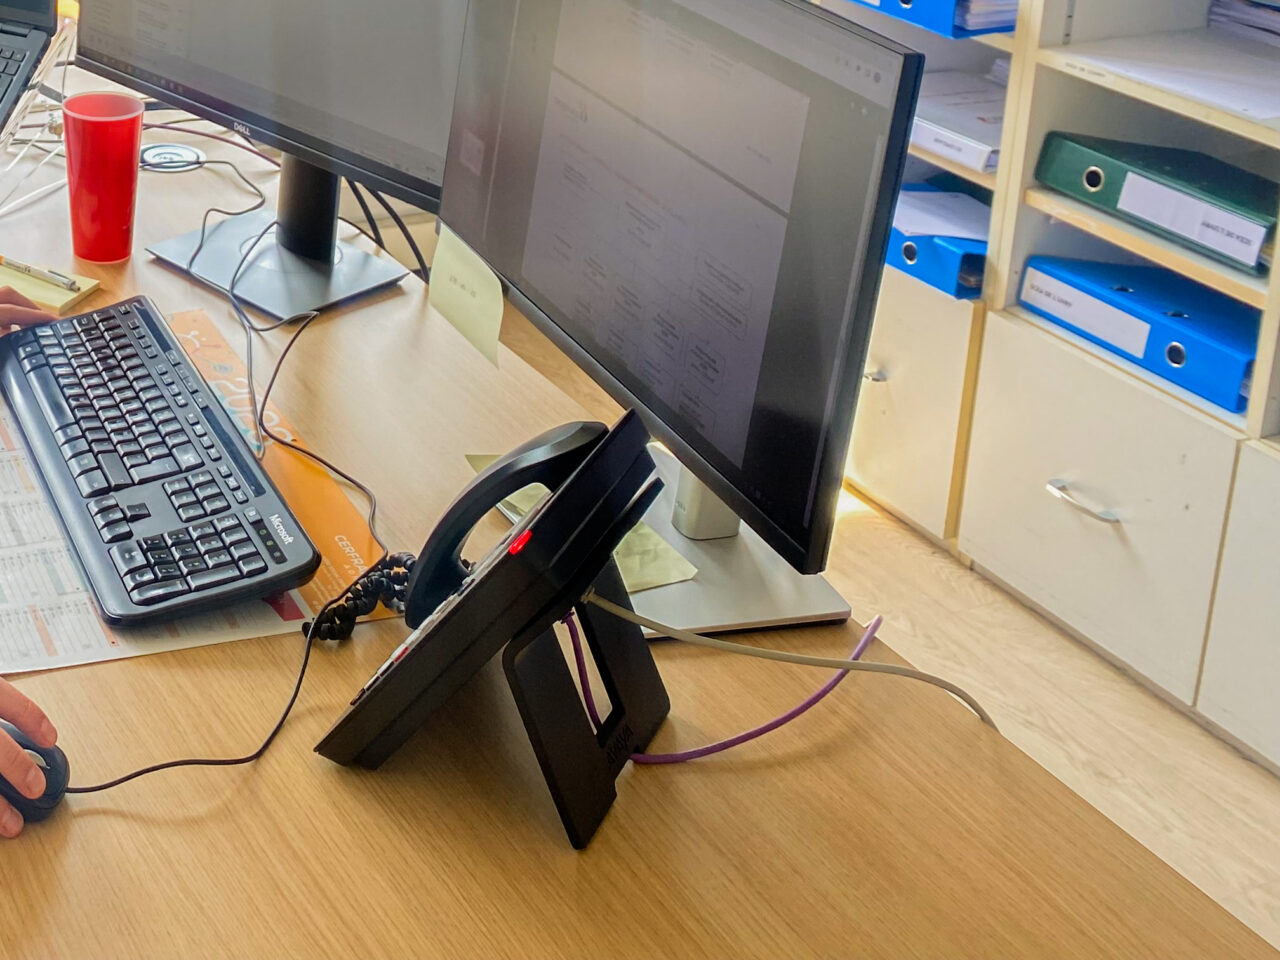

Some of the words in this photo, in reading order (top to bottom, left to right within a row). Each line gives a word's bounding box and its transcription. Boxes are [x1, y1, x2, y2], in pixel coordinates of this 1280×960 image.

[233, 122, 250, 135] DELL
[269, 514, 295, 545] Microsoft
[334, 535, 371, 576] CERFRA
